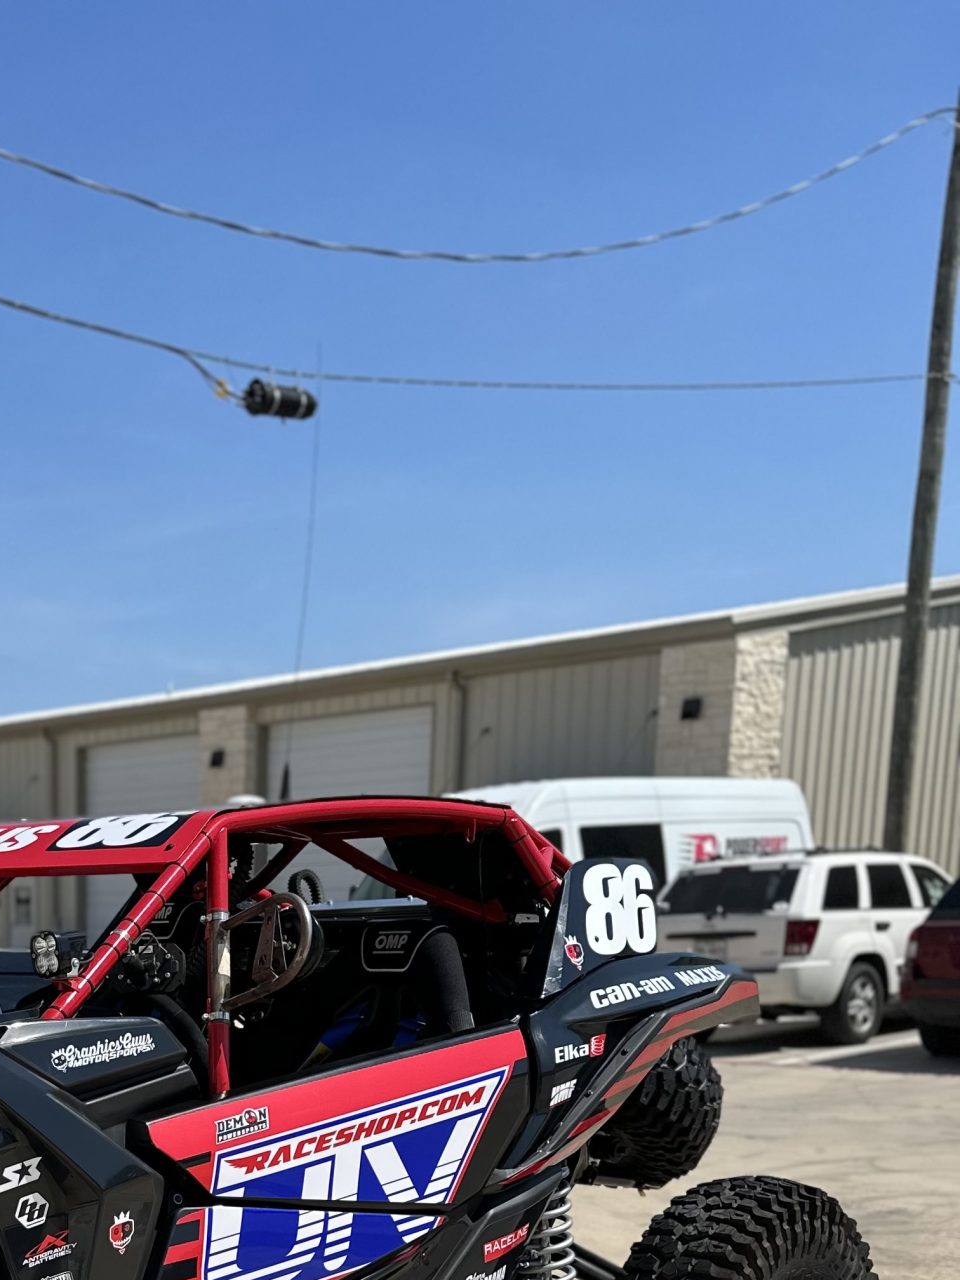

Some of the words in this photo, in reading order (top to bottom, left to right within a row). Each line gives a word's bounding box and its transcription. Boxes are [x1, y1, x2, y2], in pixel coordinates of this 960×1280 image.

[154, 906, 173, 920] MP
[583, 863, 657, 955] 86
[374, 934, 409, 950] OMP
[589, 975, 676, 1010] can-am
[674, 965, 726, 987] MAXXIS
[73, 1045, 151, 1068] MOTORSPORTS
[554, 1043, 590, 1064] Elka
[216, 1108, 267, 1133] DEMON
[230, 1086, 487, 1174] RACESHOP.COM
[483, 1224, 530, 1256] RACELINE
[22, 1242, 77, 1265] ANTIGRAVITY
[28, 1249, 72, 1268] BATTERIES
